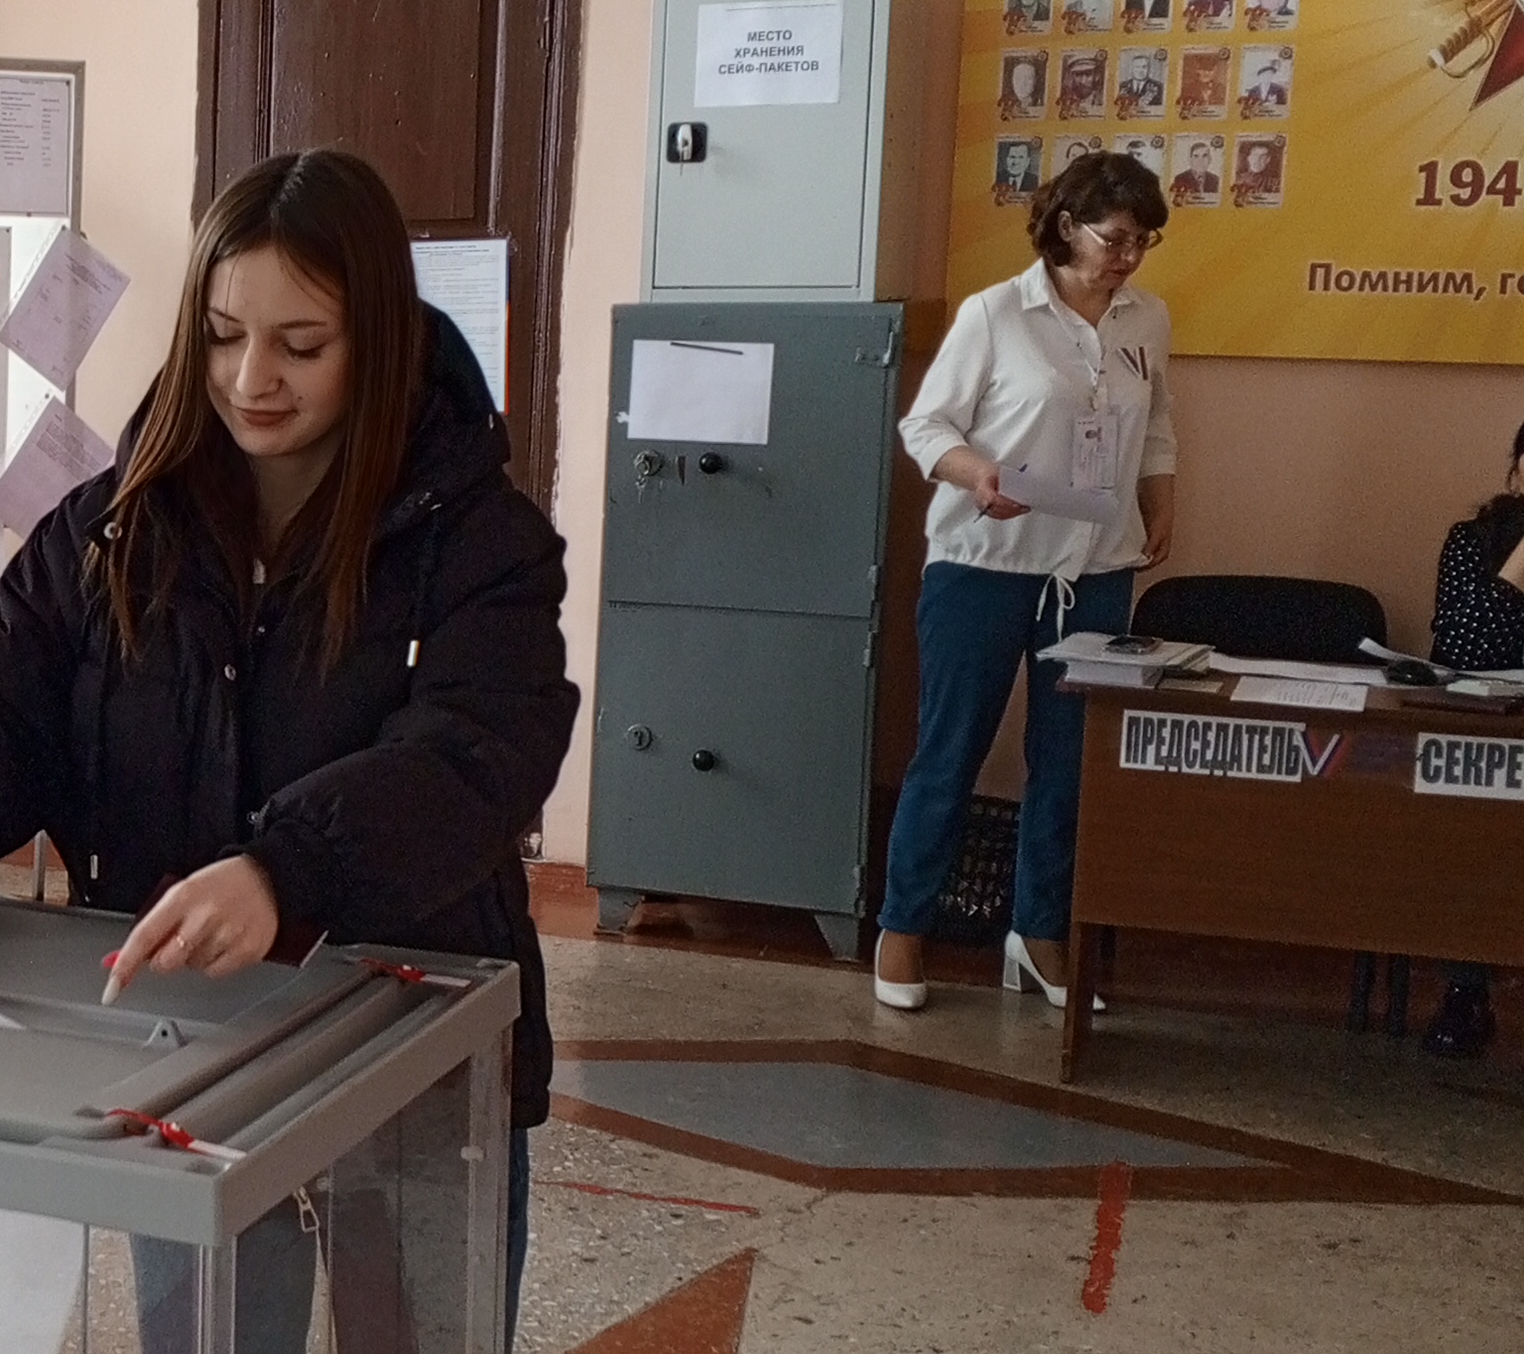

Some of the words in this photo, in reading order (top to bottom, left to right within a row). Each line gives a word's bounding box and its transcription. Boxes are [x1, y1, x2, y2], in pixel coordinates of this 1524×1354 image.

[734, 45, 805, 58] ХРАНЕНИЯ
[747, 30, 793, 42] МЕСТО
[718, 60, 820, 75] СЕЙФ-ПАКЕТОВ
[1414, 160, 1524, 207] 194
[1308, 262, 1487, 301] Помним,
[1125, 715, 1303, 778] ПРЕДСЕДАТЕЛЬ
[1421, 737, 1524, 790] СЕКРЕ
